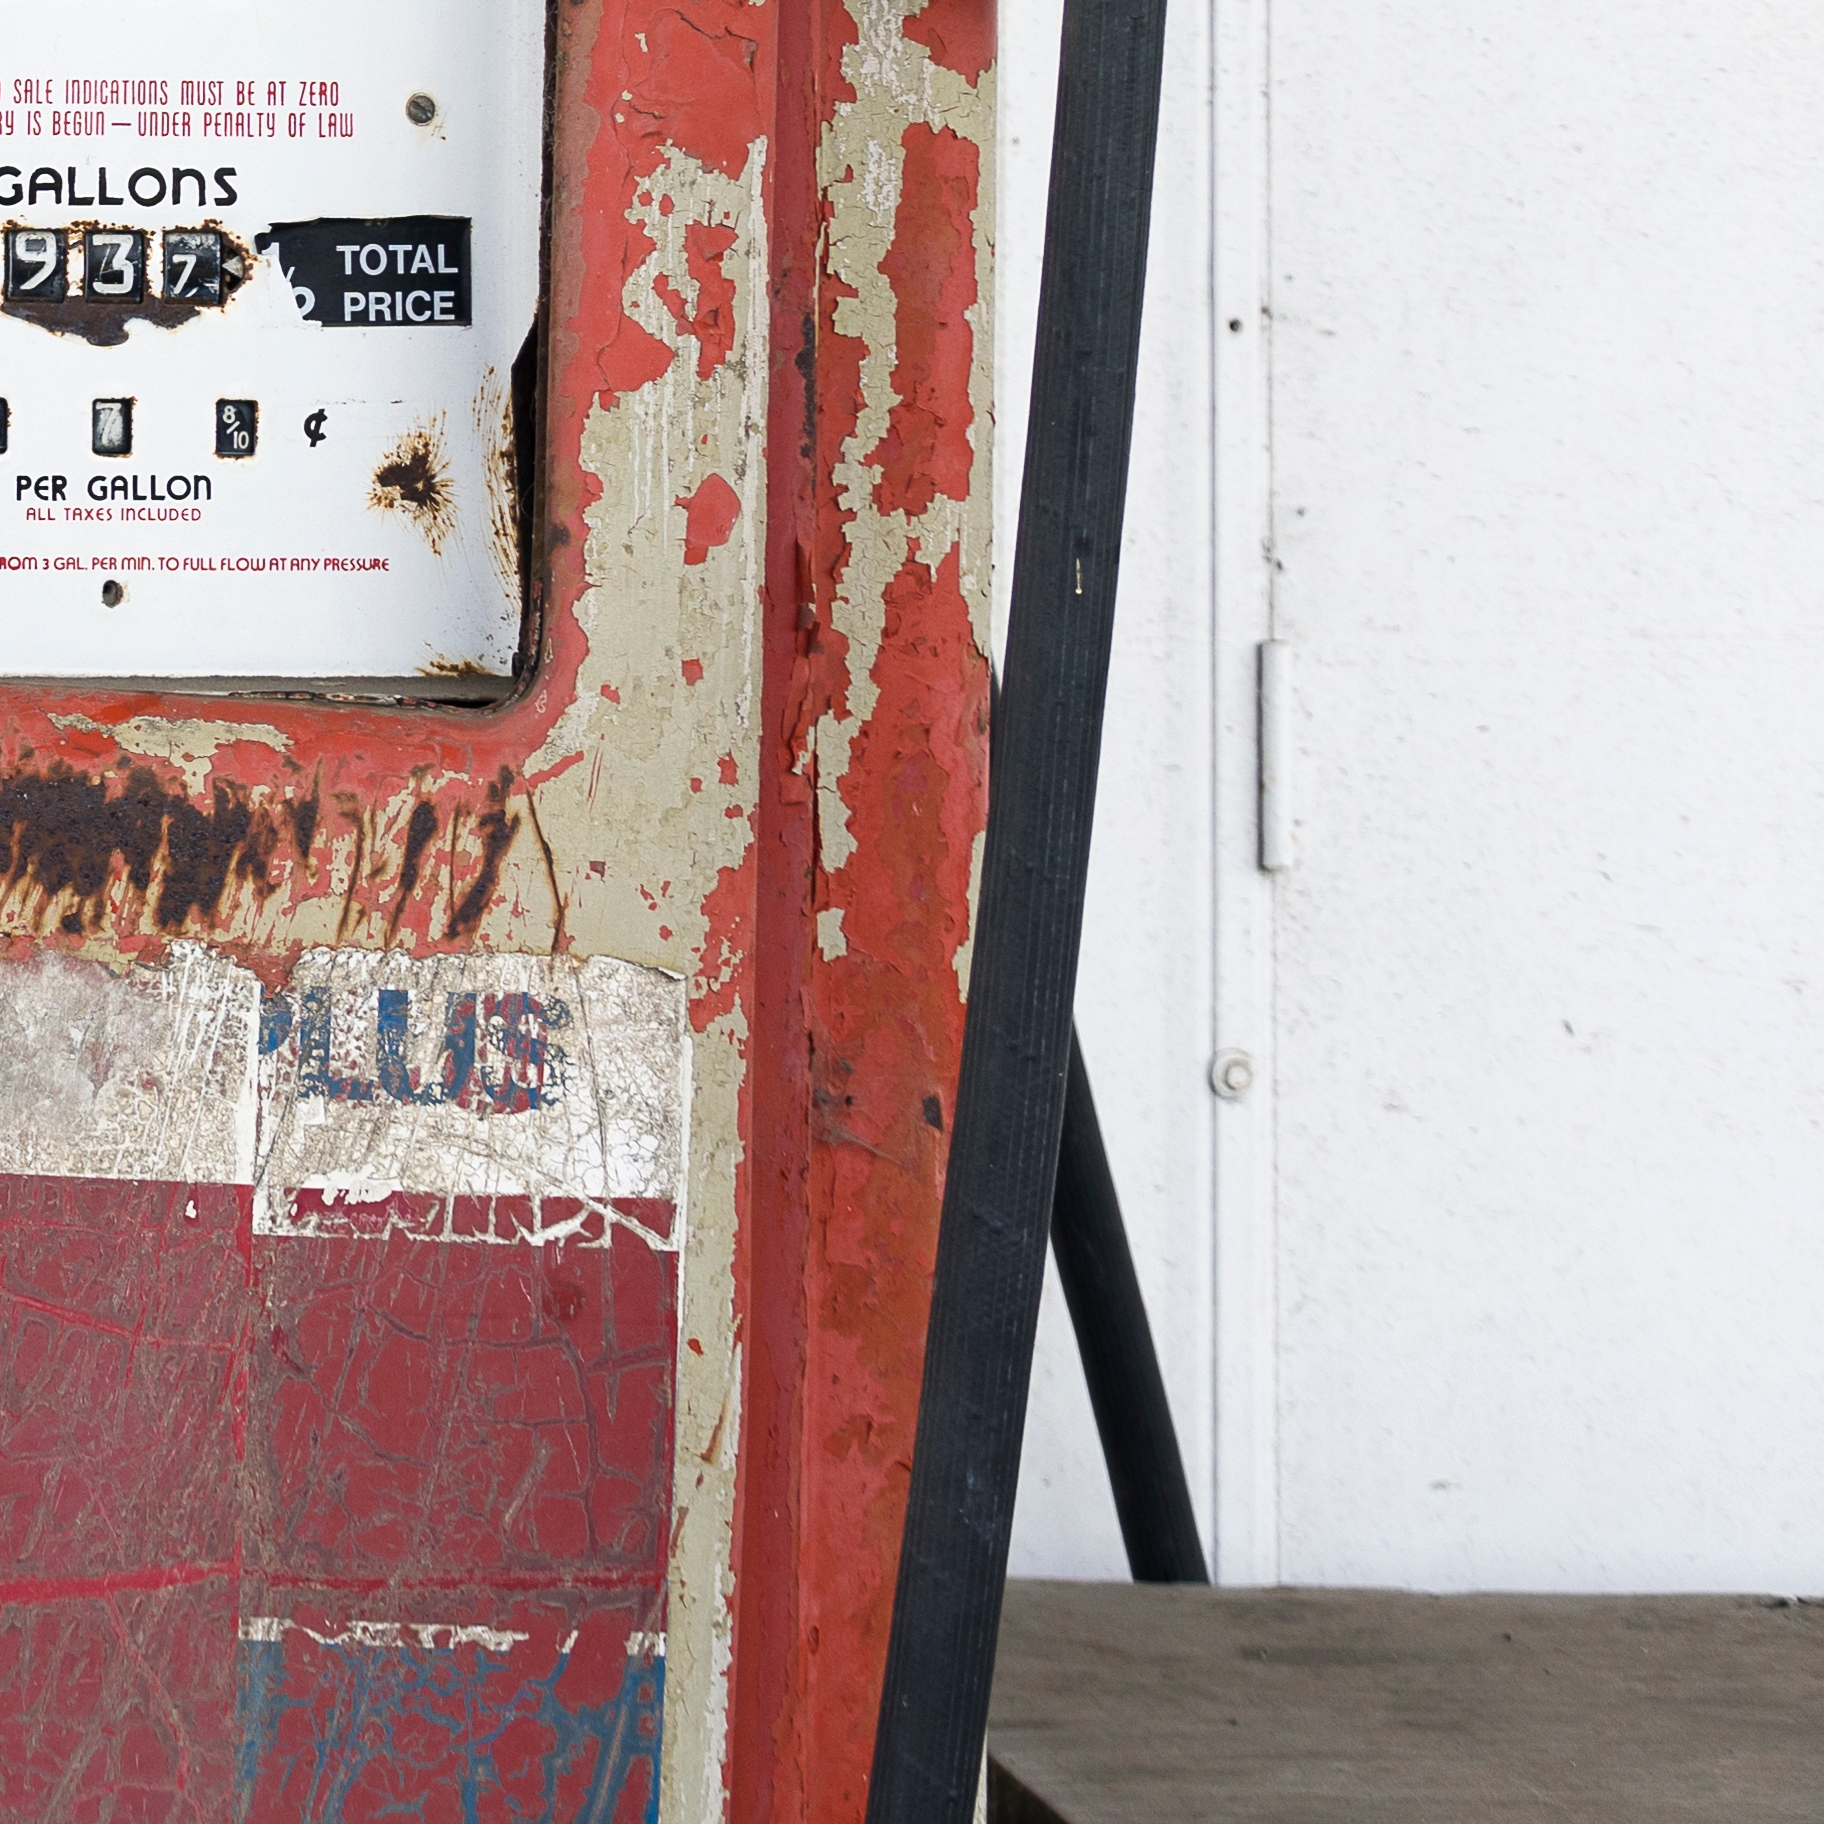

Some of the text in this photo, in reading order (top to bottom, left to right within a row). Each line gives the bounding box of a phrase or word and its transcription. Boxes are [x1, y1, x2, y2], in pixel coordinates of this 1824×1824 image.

[13, 78, 54, 105] SALE
[65, 79, 168, 106] INDICATIONS
[181, 80, 225, 106] MUST
[236, 80, 256, 106] BE
[267, 80, 287, 106] AT
[298, 81, 339, 107] ZERO
[27, 110, 42, 136] IS
[203, 111, 276, 138] PENALTY
[287, 112, 306, 138] OF
[318, 112, 354, 138] LAW
[336, 243, 459, 276] TOTAL
[344, 290, 455, 322] PRICE
[16, 474, 212, 501] PER GALLON
[26, 507, 202, 522] ALL TAXES INCLUDED
[42, 558, 50, 571] 3
[53, 557, 88, 571] GAL.
[91, 557, 118, 571] PER
[121, 557, 155, 571] MIN.
[157, 557, 180, 572] TO
[183, 557, 217, 572] FULL
[220, 557, 266, 572] FLOW
[269, 557, 288, 572] AT
[290, 557, 321, 572] ANY
[323, 557, 390, 572] PRESSURE
